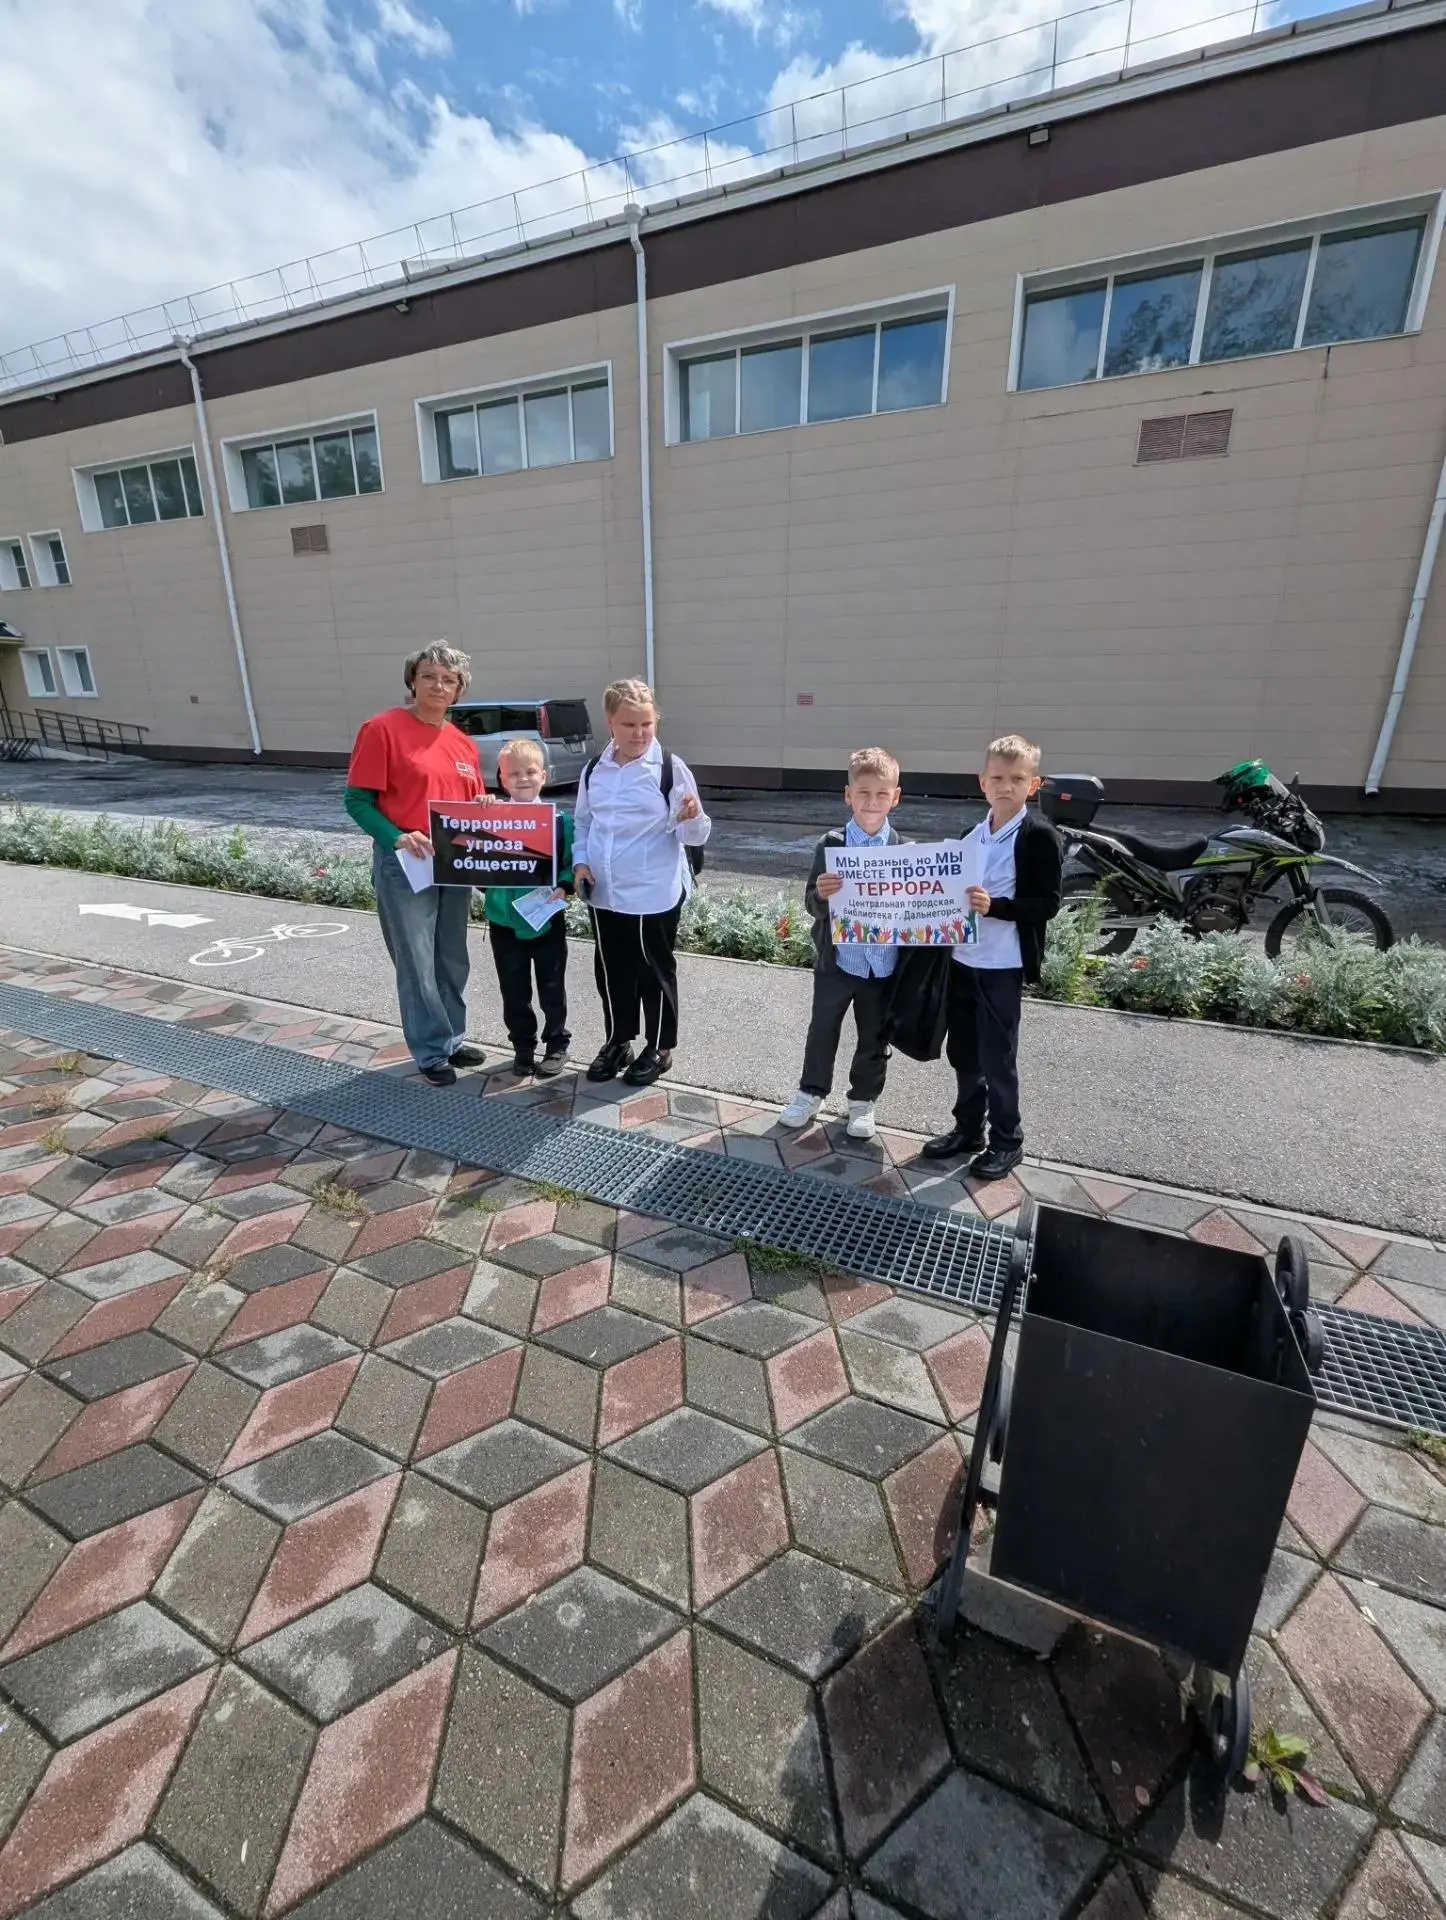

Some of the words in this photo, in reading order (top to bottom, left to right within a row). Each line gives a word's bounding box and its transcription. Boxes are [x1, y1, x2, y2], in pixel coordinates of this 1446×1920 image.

[440, 815, 536, 832] Терроризм
[465, 839, 524, 852] угроза
[453, 856, 537, 873] обществу
[864, 858, 913, 870] разные,
[917, 857, 931, 865] но
[855, 880, 945, 896] ТЕРРОРА
[848, 899, 906, 909] Центральная
[907, 899, 955, 910] городская
[843, 907, 892, 920] библиотека
[894, 912, 902, 920] г.
[904, 908, 962, 921] Дальнегорск
